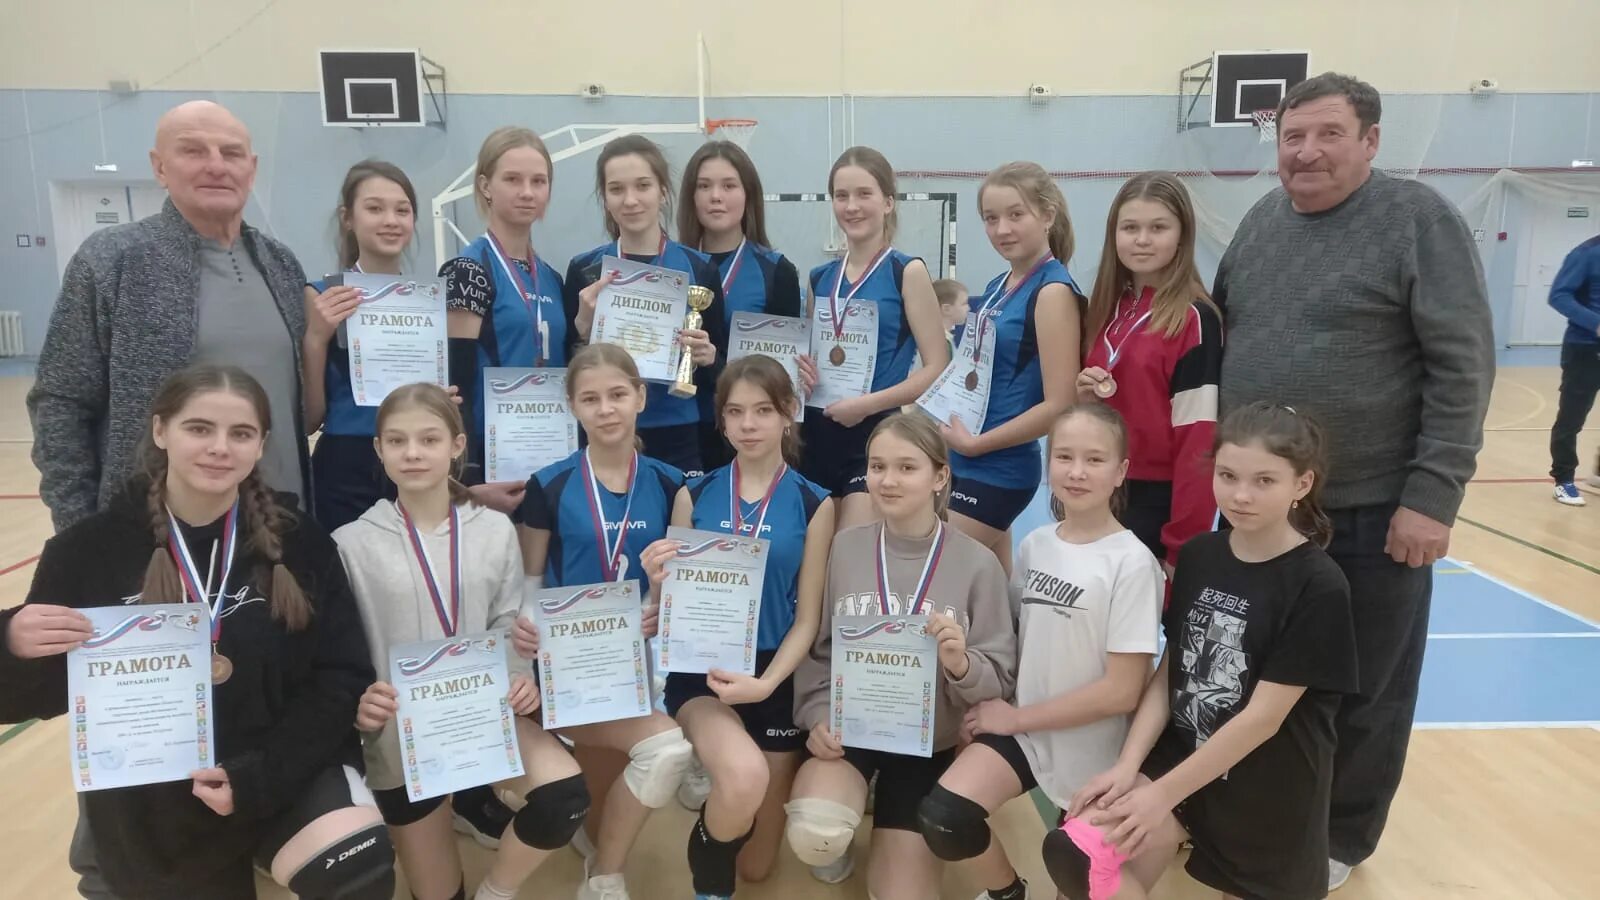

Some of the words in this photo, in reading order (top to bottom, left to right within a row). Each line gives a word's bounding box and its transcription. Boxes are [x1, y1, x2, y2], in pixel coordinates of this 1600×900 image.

[610, 294, 672, 315] ДИПЛОМ
[360, 313, 434, 328] ГРАМОТА
[739, 339, 797, 355] ГРАМОТА
[497, 402, 565, 414] ГРАМОТА
[676, 567, 750, 587] ГРАМОТА
[1199, 586, 1250, 615] 起死回生
[549, 615, 629, 638] ГРАМОТА
[87, 653, 192, 678] ГРАМОТА
[845, 650, 922, 669] ГРАМОТА
[410, 672, 495, 702] ГРАМОТА
[339, 837, 376, 862] DEMIX
